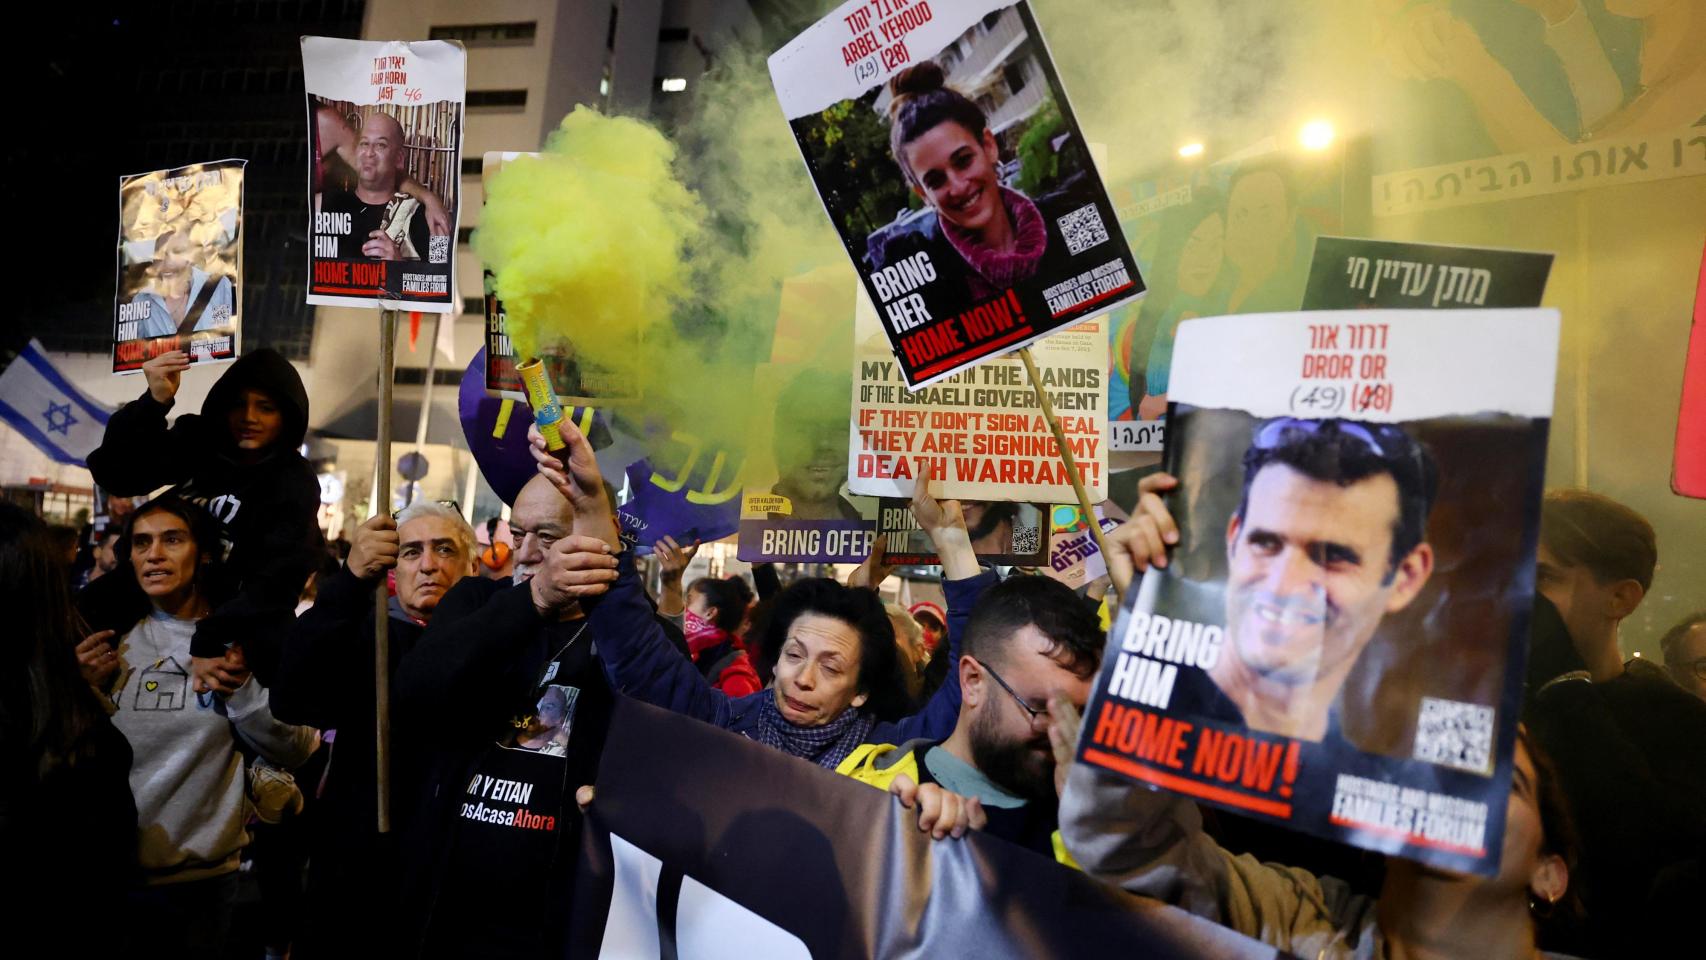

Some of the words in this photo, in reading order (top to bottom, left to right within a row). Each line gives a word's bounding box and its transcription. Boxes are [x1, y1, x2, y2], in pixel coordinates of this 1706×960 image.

[842, 30, 883, 67] ARBEL
[879, 1, 932, 43] YEHOUD
[844, 5, 871, 35] יהוד
[855, 56, 879, 85] (29)
[880, 40, 910, 72] (28)
[384, 71, 407, 85] HORN
[405, 88, 422, 102] 46
[1554, 142, 1648, 183] אותו
[315, 212, 352, 235] BRING
[315, 236, 338, 258] HIM
[314, 261, 349, 284] HOME
[351, 261, 387, 287] NOW!
[402, 281, 429, 292] FAMILIES
[430, 282, 447, 293] FORUM
[870, 251, 937, 303] BRING
[1042, 277, 1078, 301] HOSTAGES
[1077, 271, 1093, 286] AND
[1091, 258, 1124, 280] MISSING
[1346, 256, 1369, 289] חי
[1369, 258, 1433, 298] עדיין
[1432, 265, 1492, 307] מתן
[1047, 284, 1095, 315] FAMILIES
[1091, 268, 1131, 297] FORUM
[119, 300, 151, 322] BRING
[885, 293, 933, 334] HER
[118, 322, 138, 342] HIM
[901, 318, 966, 368] HOME
[959, 288, 1026, 343] NOW!
[1308, 325, 1340, 349] אור
[1347, 325, 1389, 349] דרור
[490, 334, 513, 356] HIM
[862, 361, 892, 380] MY
[964, 366, 976, 384] IN
[981, 365, 1021, 386] THE
[1302, 354, 1353, 379] DROR
[1360, 354, 1387, 379] OR
[861, 385, 874, 403] OF
[876, 386, 894, 403] THE
[898, 387, 970, 406] ISRAELI
[1289, 386, 1345, 412] (49)
[1352, 383, 1393, 411] (48)
[859, 409, 877, 427] IF
[880, 410, 928, 428] THEY
[931, 412, 984, 431] DON'T
[987, 414, 1028, 432] SIGN
[1032, 416, 1047, 433] A
[860, 430, 917, 452] THEY
[921, 432, 968, 454] ARE
[973, 434, 1062, 458] SIGNING
[1066, 437, 1099, 459] MY
[857, 454, 947, 481] DEATH
[955, 457, 1099, 487] WARRANT!
[882, 508, 923, 530] BRIN
[761, 529, 820, 555] BRING
[825, 530, 877, 557] OFER
[1122, 610, 1223, 670] BRING
[1107, 652, 1178, 710] HIM
[1093, 700, 1193, 769] HOME
[1192, 728, 1301, 799] NOW!
[482, 775, 494, 797] Y
[491, 779, 533, 804] EITAN
[1331, 791, 1413, 833] FAMILIES
[1413, 810, 1487, 849] FORUM
